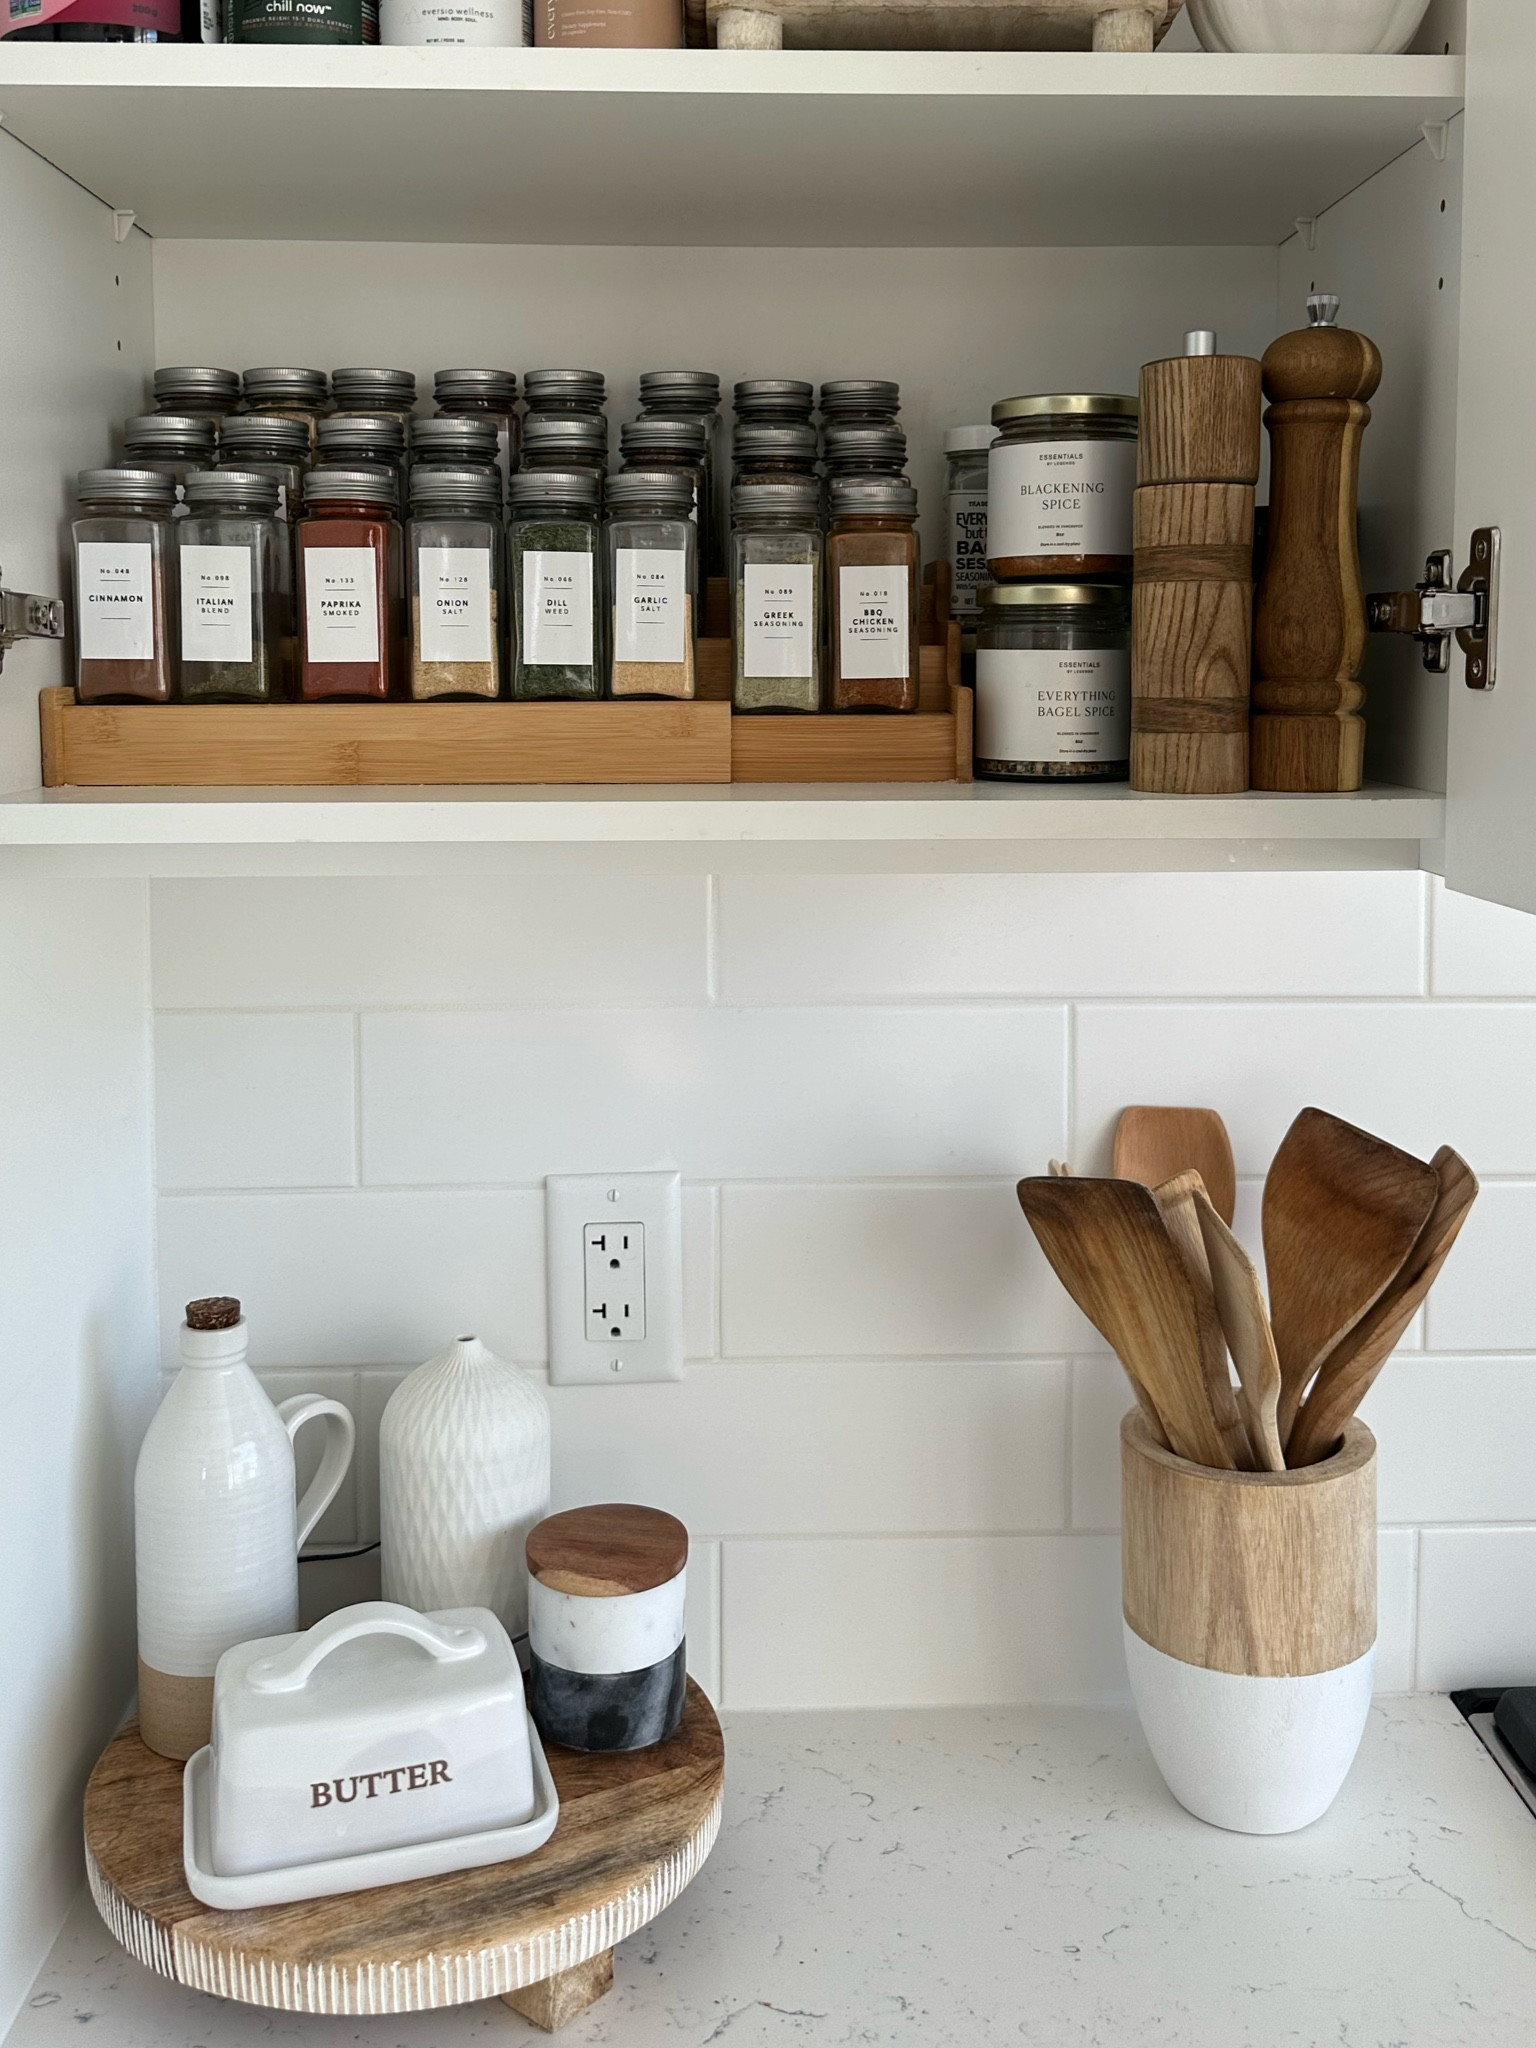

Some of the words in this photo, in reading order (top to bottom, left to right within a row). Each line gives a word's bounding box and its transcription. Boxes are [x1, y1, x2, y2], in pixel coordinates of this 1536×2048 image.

[266, 0, 292, 12] chill
[422, 8, 454, 16] eversio
[455, 7, 494, 19] wellness
[1039, 453, 1084, 461] ESSENTIALS
[1020, 482, 1105, 496] BLACKENING
[1042, 498, 1081, 511] SPICE
[956, 541, 987, 555] BA
[956, 558, 988, 570] SES
[88, 594, 143, 603] CINNAMON
[196, 597, 234, 606] ITALIAN
[436, 599, 469, 607] ONION
[546, 598, 568, 607] DILL
[633, 596, 668, 605] GARLIC
[320, 600, 362, 608] PAPRIKA
[322, 609, 360, 617] SMOKED
[763, 611, 794, 619] GREEK
[863, 608, 883, 618] BBQ
[852, 617, 895, 626] CHICKEN
[848, 626, 899, 634] SEASONING
[1037, 690, 1116, 701] EVERYTHING
[1037, 706, 1081, 718] BAGEL
[1084, 706, 1116, 717] SPICE
[310, 1759, 453, 1808] BUTTER
